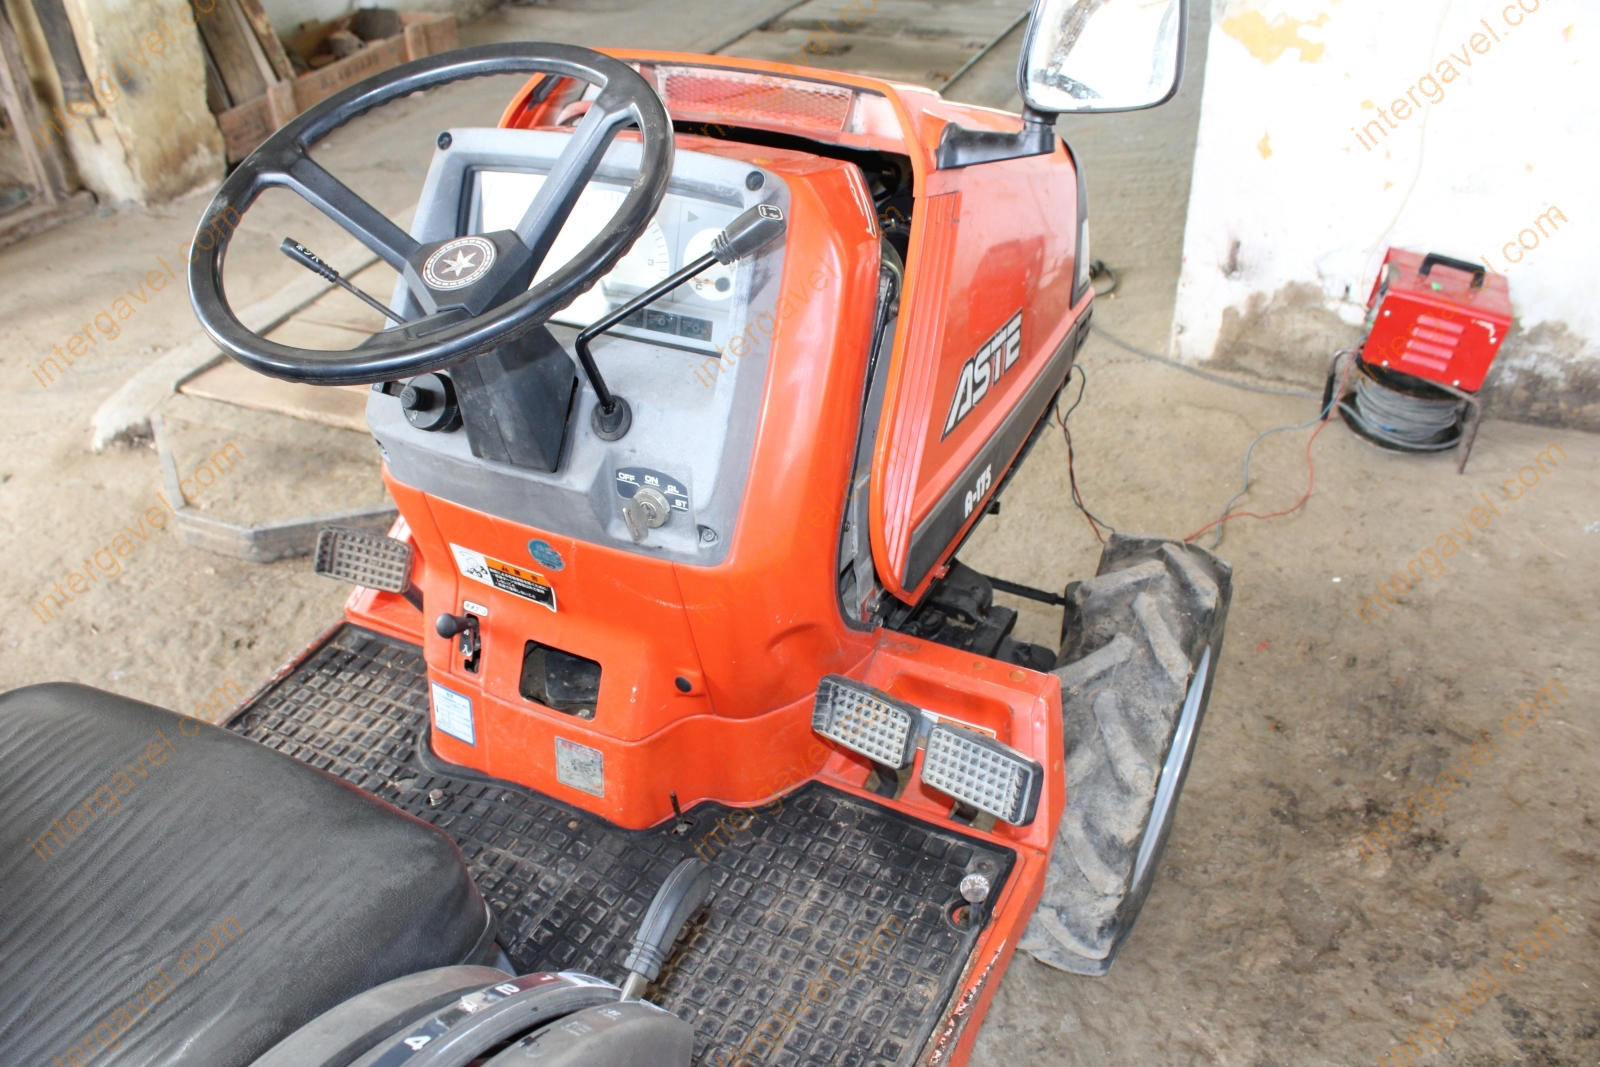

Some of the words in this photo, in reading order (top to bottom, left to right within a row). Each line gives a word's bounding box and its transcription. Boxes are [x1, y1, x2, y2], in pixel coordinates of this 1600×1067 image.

[943, 310, 1022, 436] ASTE
[618, 471, 636, 482] OFF
[644, 474, 659, 485] ON
[667, 484, 680, 494] GL
[965, 463, 993, 519] A-175
[674, 498, 688, 508] ST
[461, 644, 470, 655] 入
[494, 983, 520, 996] 2
[404, 1035, 431, 1051] 4
